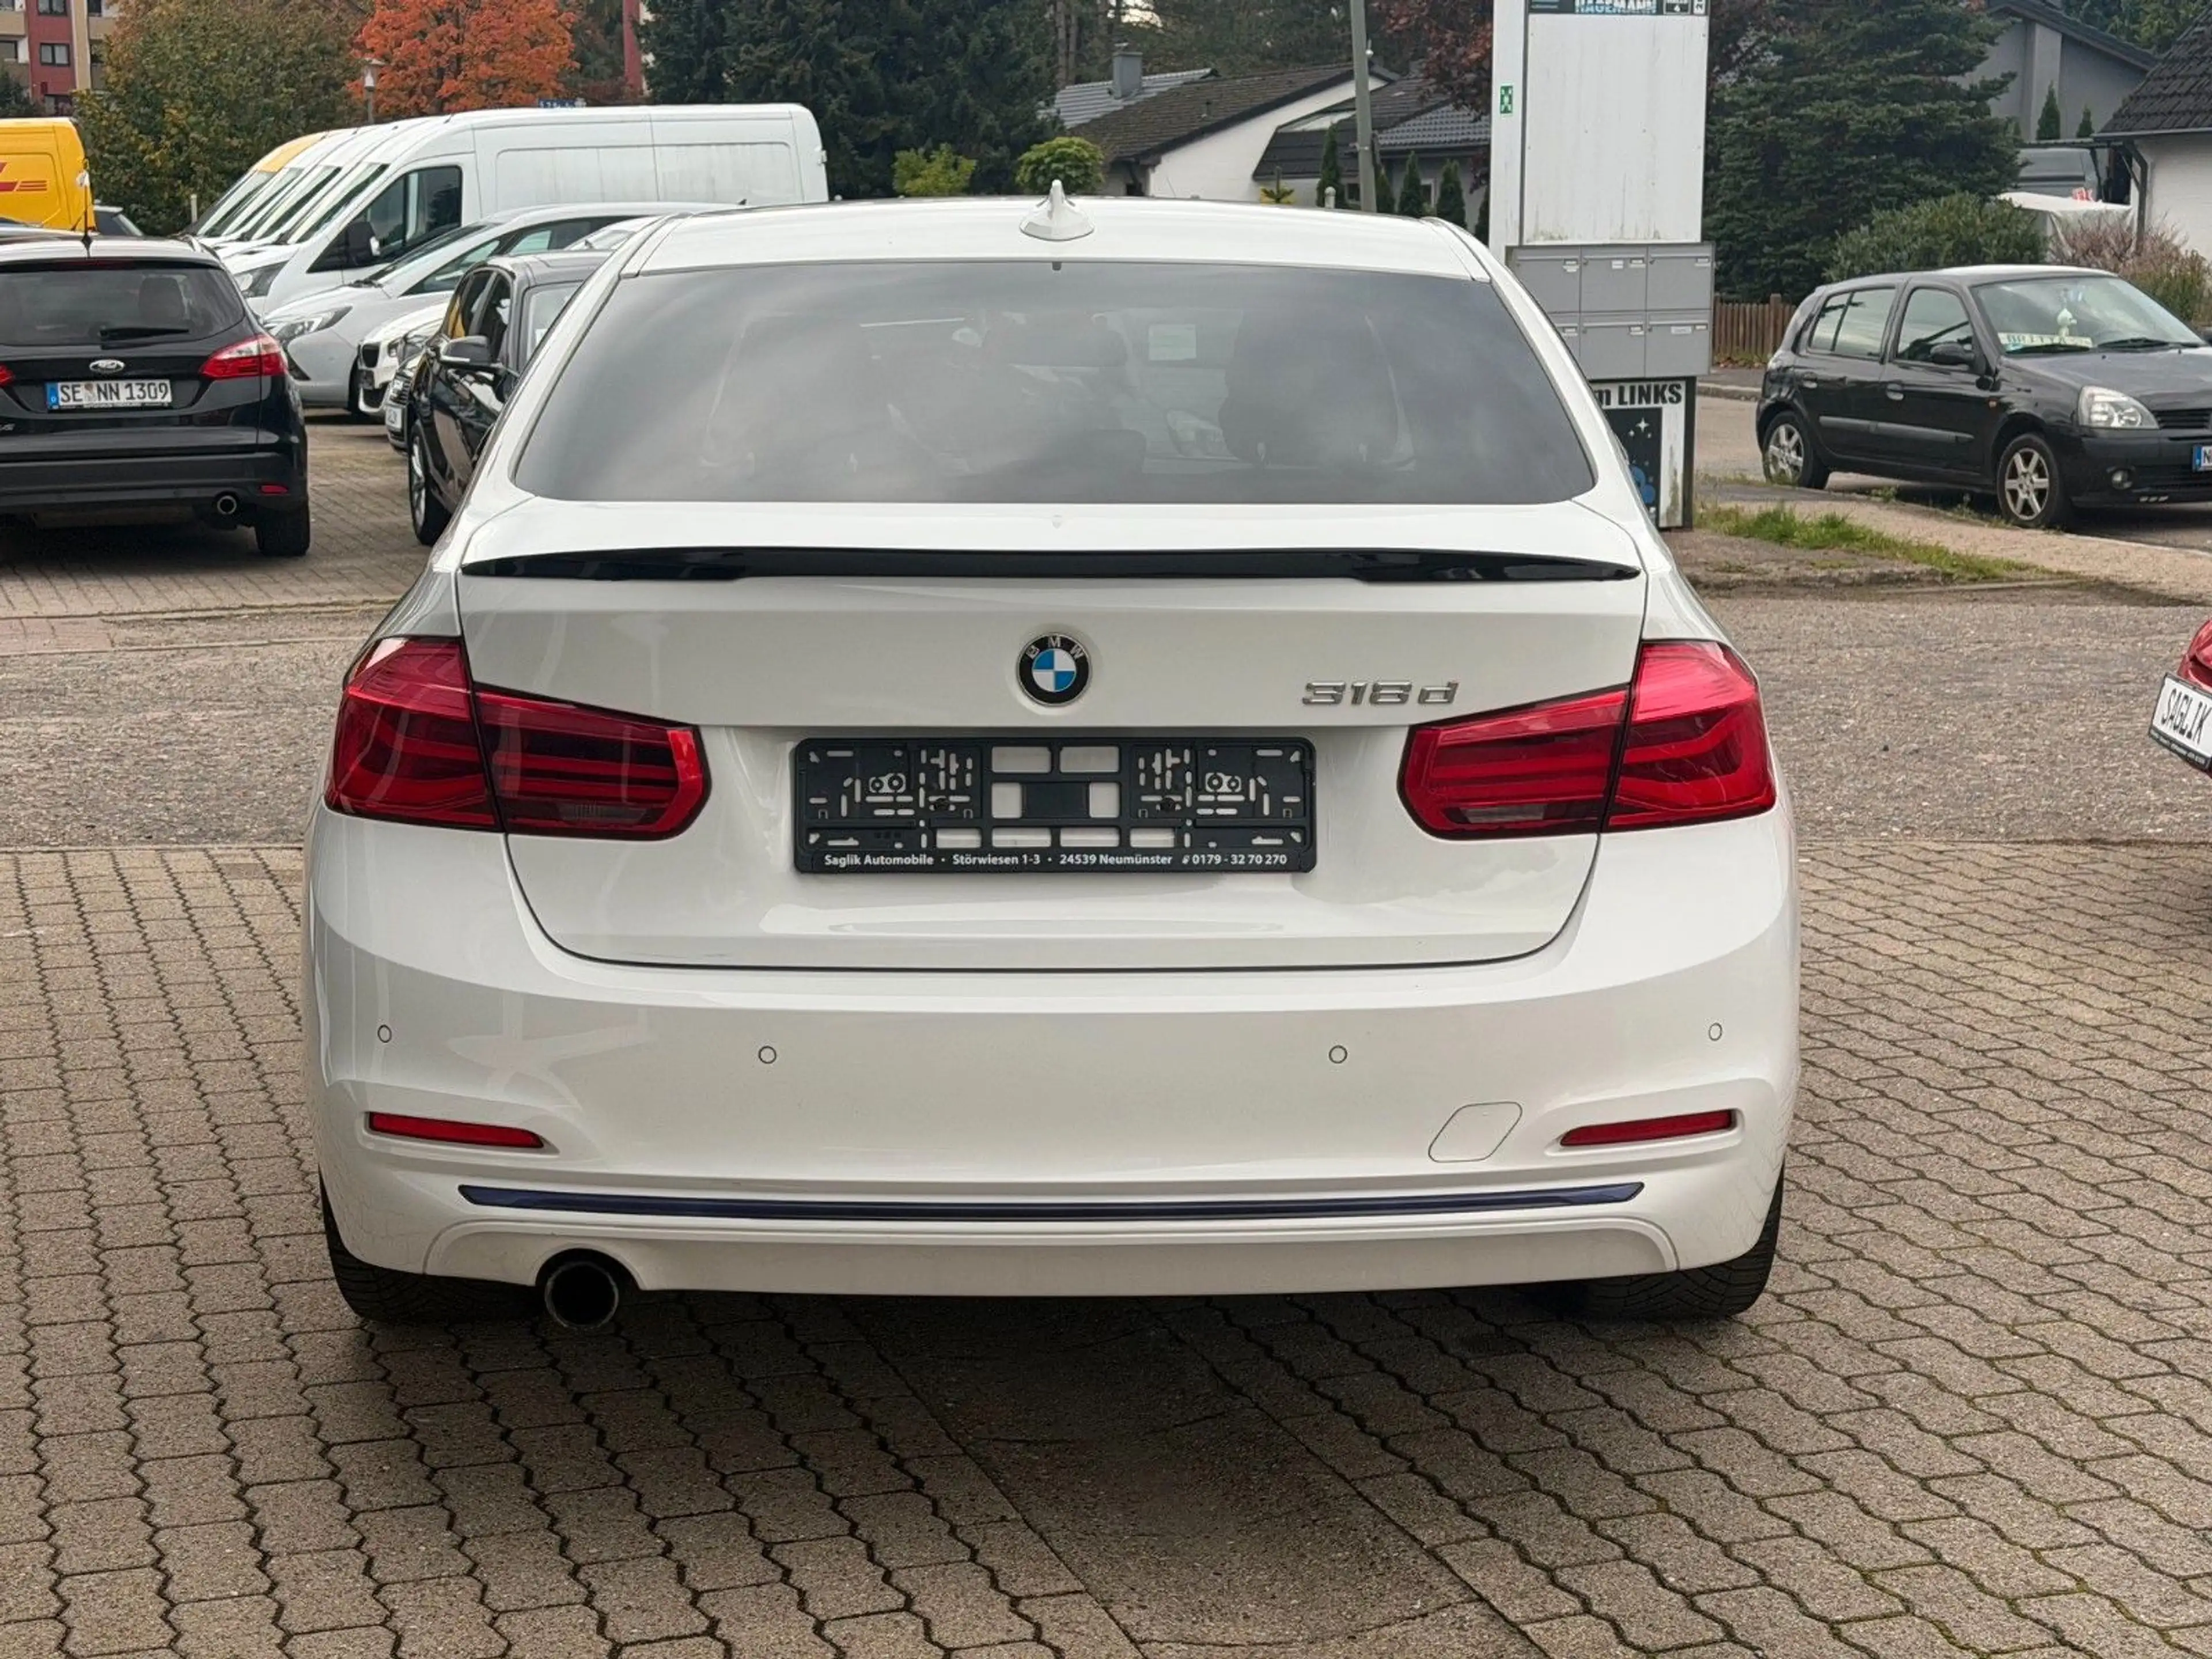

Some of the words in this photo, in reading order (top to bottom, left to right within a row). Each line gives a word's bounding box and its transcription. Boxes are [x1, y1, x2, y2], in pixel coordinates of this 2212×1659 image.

[60, 384, 82, 402] SE
[97, 383, 119, 400] NN
[125, 382, 168, 399] 1309
[1619, 384, 1682, 405] LINKS
[1025, 634, 1084, 659] BMW
[2161, 688, 2212, 744] SAGLIK
[824, 854, 861, 867] Saglik
[864, 854, 934, 865] Automobile
[952, 853, 1018, 865] Störwiesen
[1022, 854, 1040, 864] 1-3
[1059, 854, 1096, 865] 24539
[1099, 853, 1172, 865] Neumünster
[1191, 854, 1222, 864] 0179
[1230, 854, 1245, 864] 32
[1248, 854, 1263, 864] 70
[1265, 854, 1287, 864] 270
